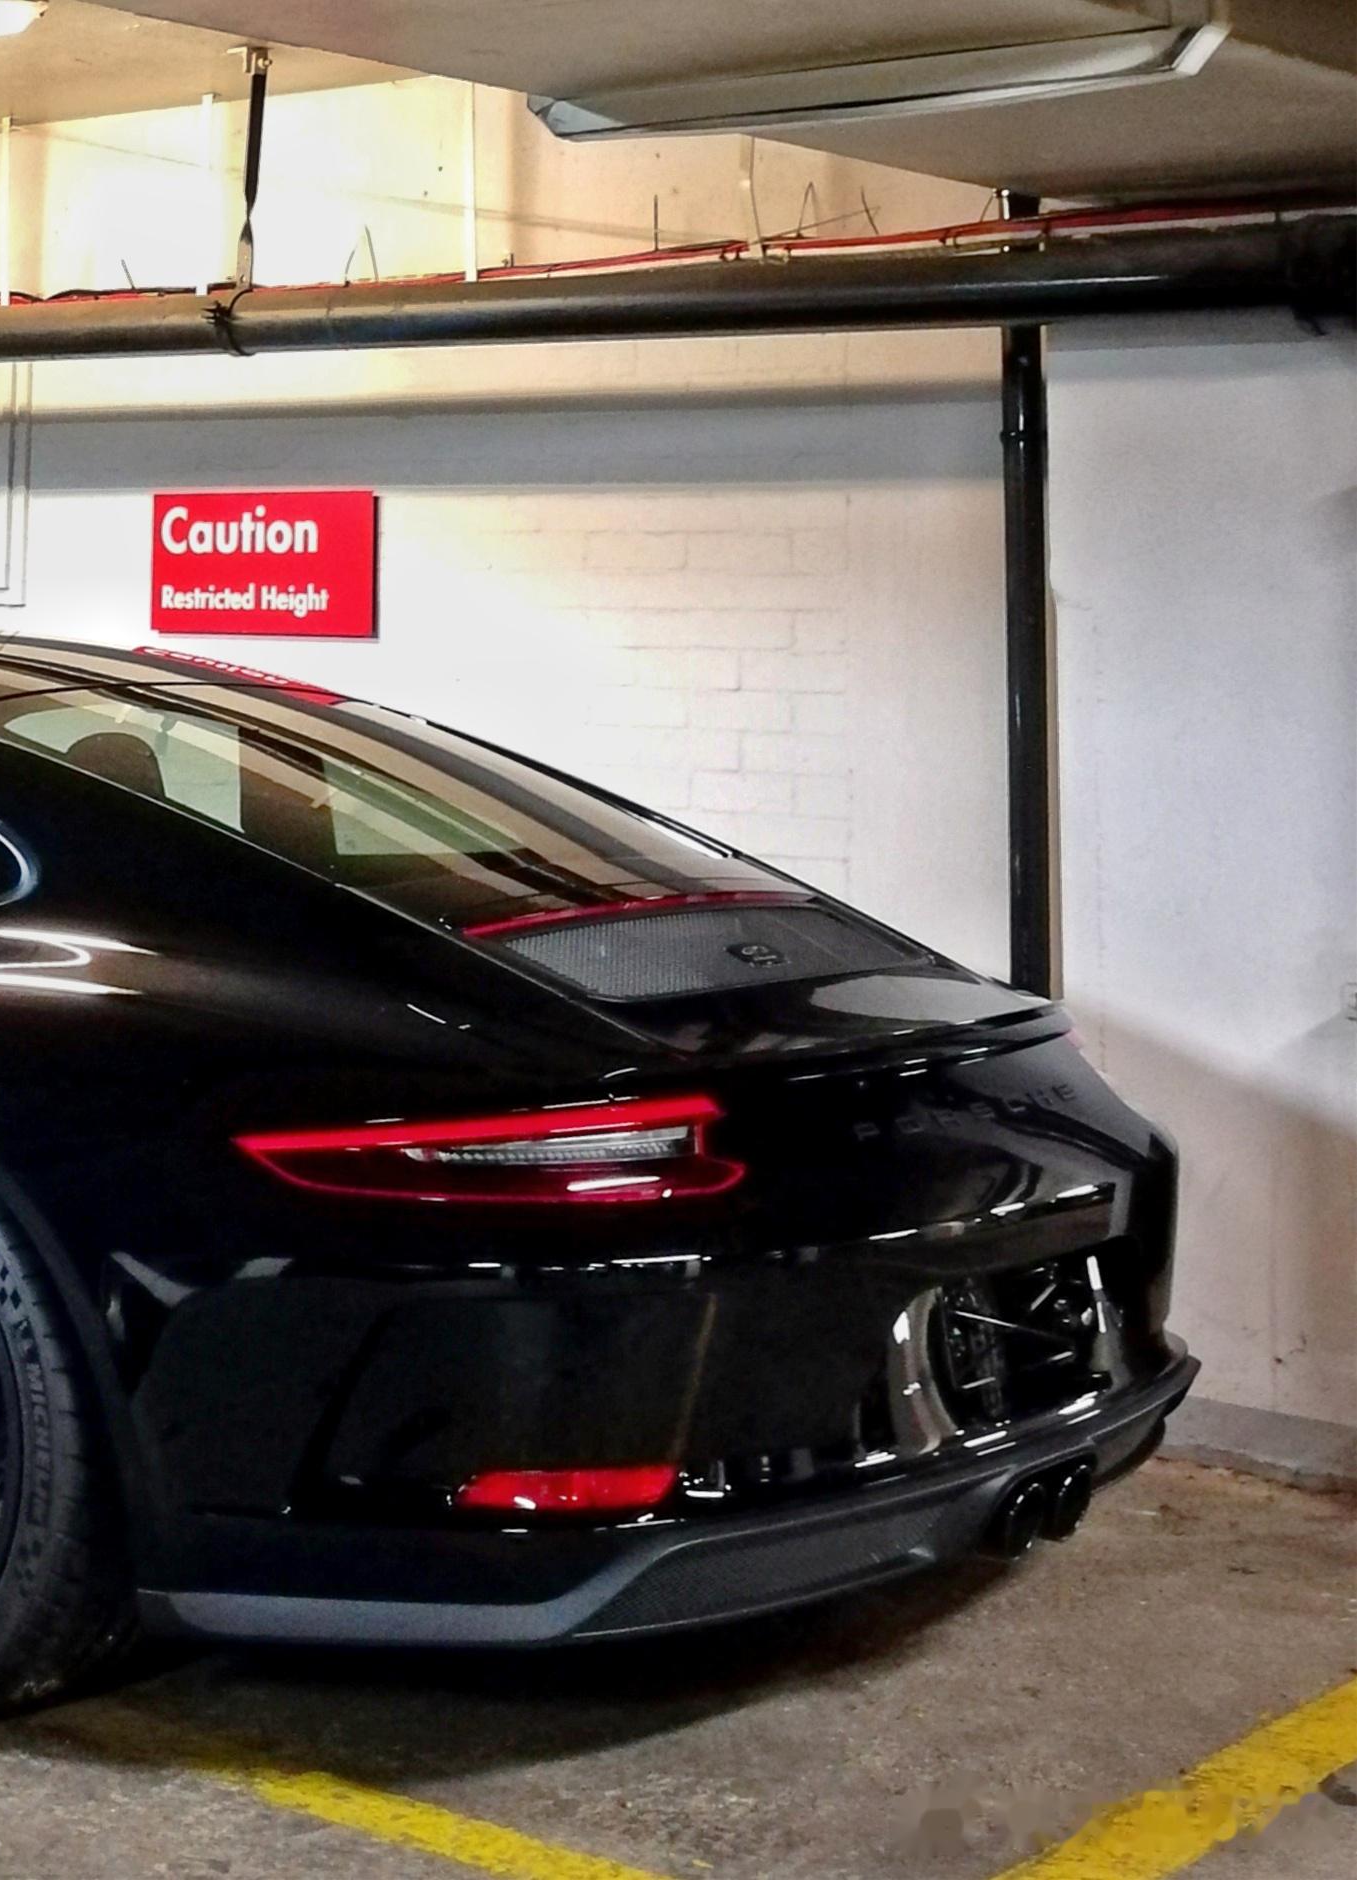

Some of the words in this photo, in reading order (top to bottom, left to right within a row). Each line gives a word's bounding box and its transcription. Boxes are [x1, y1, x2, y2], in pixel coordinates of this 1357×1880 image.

[161, 505, 319, 555] Caution
[160, 583, 256, 610] Restricted
[261, 583, 330, 618] Height
